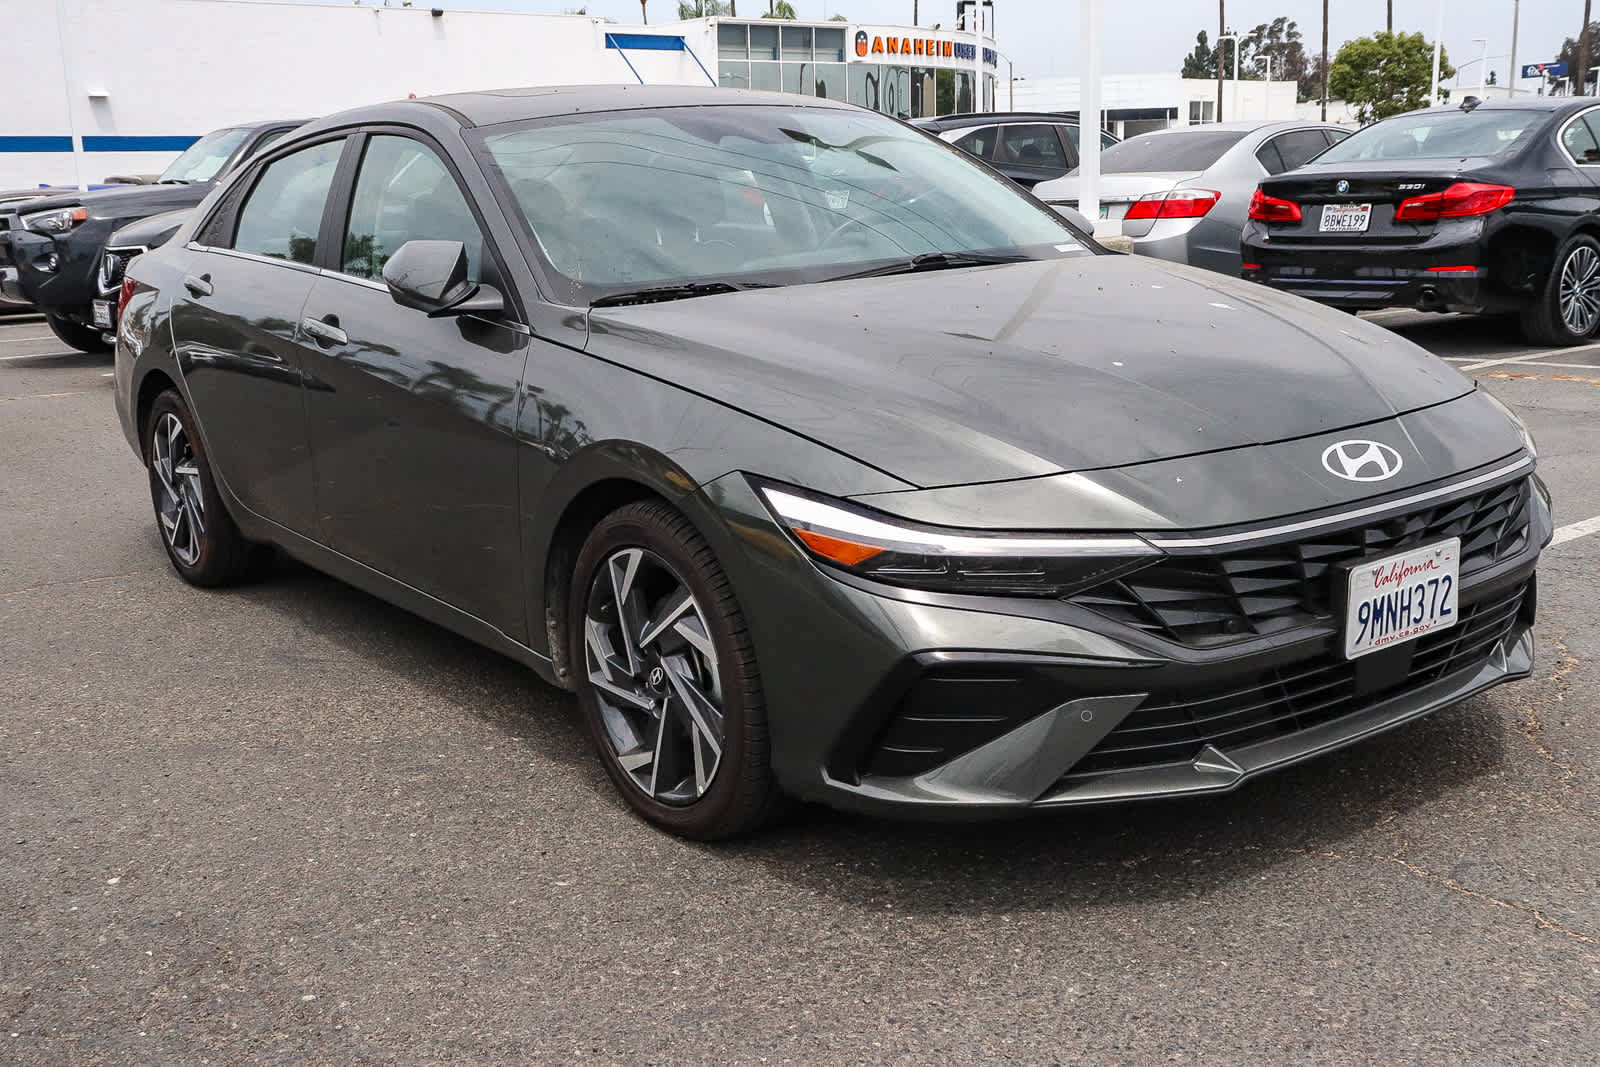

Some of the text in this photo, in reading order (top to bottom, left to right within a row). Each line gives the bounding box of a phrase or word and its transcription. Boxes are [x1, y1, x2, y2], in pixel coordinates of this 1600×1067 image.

[871, 36, 953, 57] ANAHEIM
[1323, 214, 1366, 227] 8BWE199
[1374, 559, 1441, 589] California
[1355, 574, 1453, 645] 9MNH372
[1374, 623, 1432, 646] dmv.ca.gov
